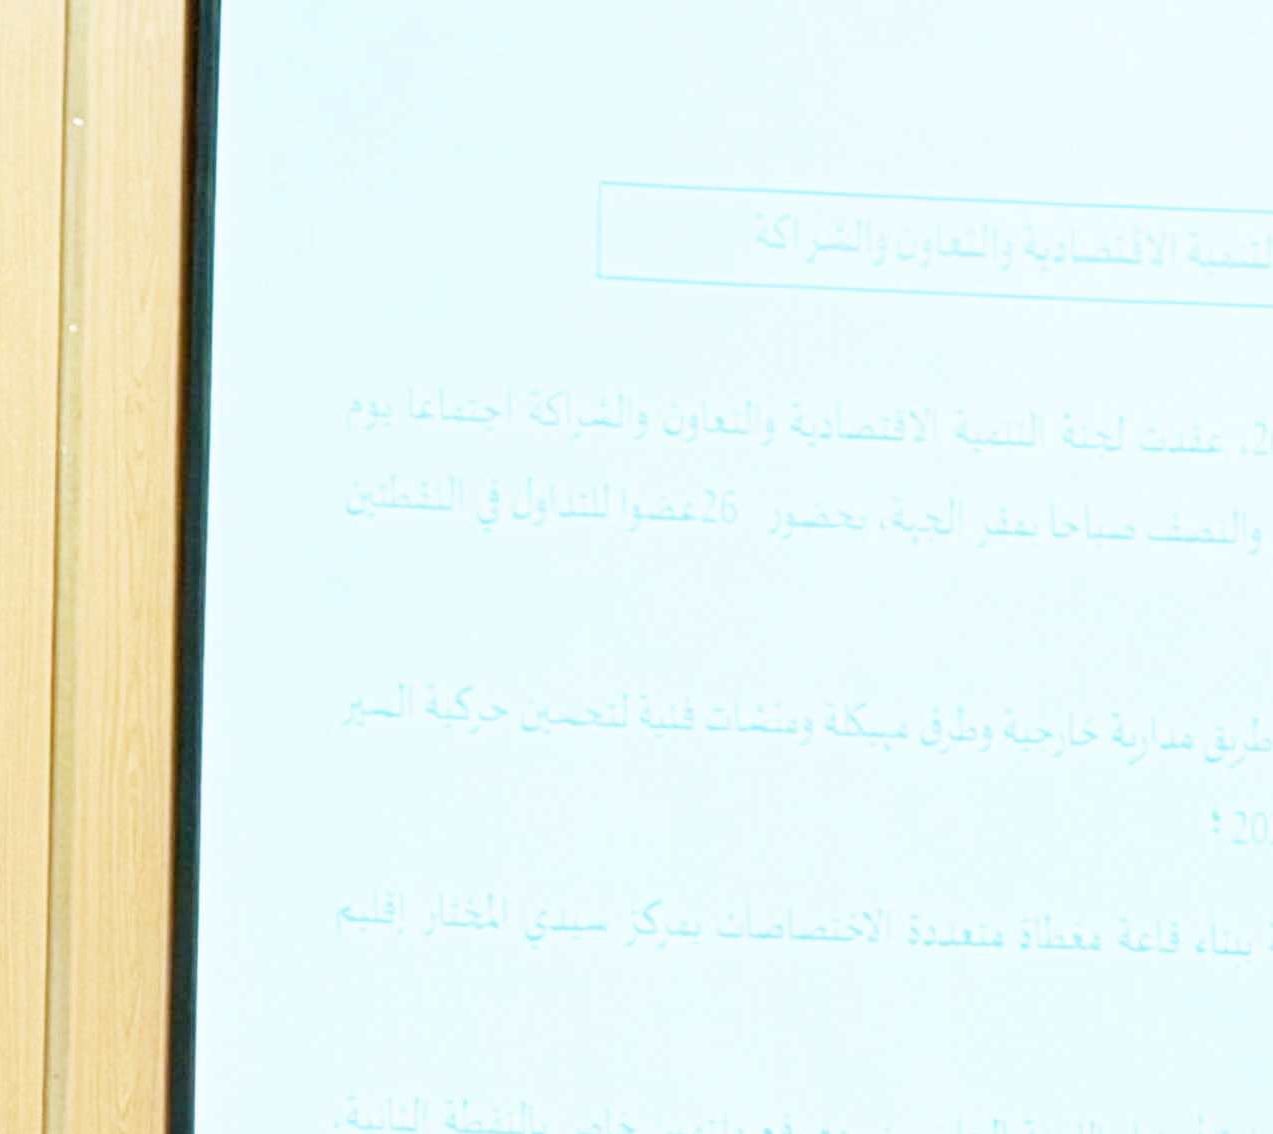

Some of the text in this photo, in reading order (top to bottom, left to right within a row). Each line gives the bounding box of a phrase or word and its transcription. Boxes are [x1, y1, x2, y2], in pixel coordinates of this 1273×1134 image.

[754, 212, 1273, 276] لتنمية الاقتصادية والتعاون والشراكة
[345, 398, 393, 432] يوم
[407, 386, 513, 432] اجتماعا
[528, 388, 649, 442] والشراكة
[661, 398, 776, 448] والتعاون
[789, 401, 938, 449] الاقتصادية
[953, 408, 1045, 455] التنمية
[1061, 411, 1126, 459] لجنة
[1138, 424, 1225, 455] عقدت
[343, 472, 464, 519] النقطتين
[475, 477, 501, 535] في
[510, 474, 611, 528] للتداول
[766, 502, 867, 537] بحضور
[976, 506, 1039, 549] بمقر
[1048, 503, 1137, 542] صباحا
[1146, 508, 1263, 557] والنصف
[340, 681, 413, 728] السير
[424, 682, 510, 736] حركية
[519, 691, 630, 736] لتحسين
[638, 692, 696, 739] فنية
[823, 700, 910, 753] مهيكلة
[919, 704, 994, 756] وطرق
[1002, 706, 1100, 759] خارجية
[1110, 710, 1195, 767] مدارية
[1230, 809, 1273, 847] 20
[335, 890, 405, 936] إقليم
[421, 892, 508, 938] المختار
[523, 908, 609, 951] سيدي
[624, 897, 703, 951] بمركز
[715, 906, 891, 944] الاختصاصات
[906, 913, 1005, 949] متعددة
[1018, 912, 1103, 953] مغطاة
[1116, 915, 1181, 955] قاعة
